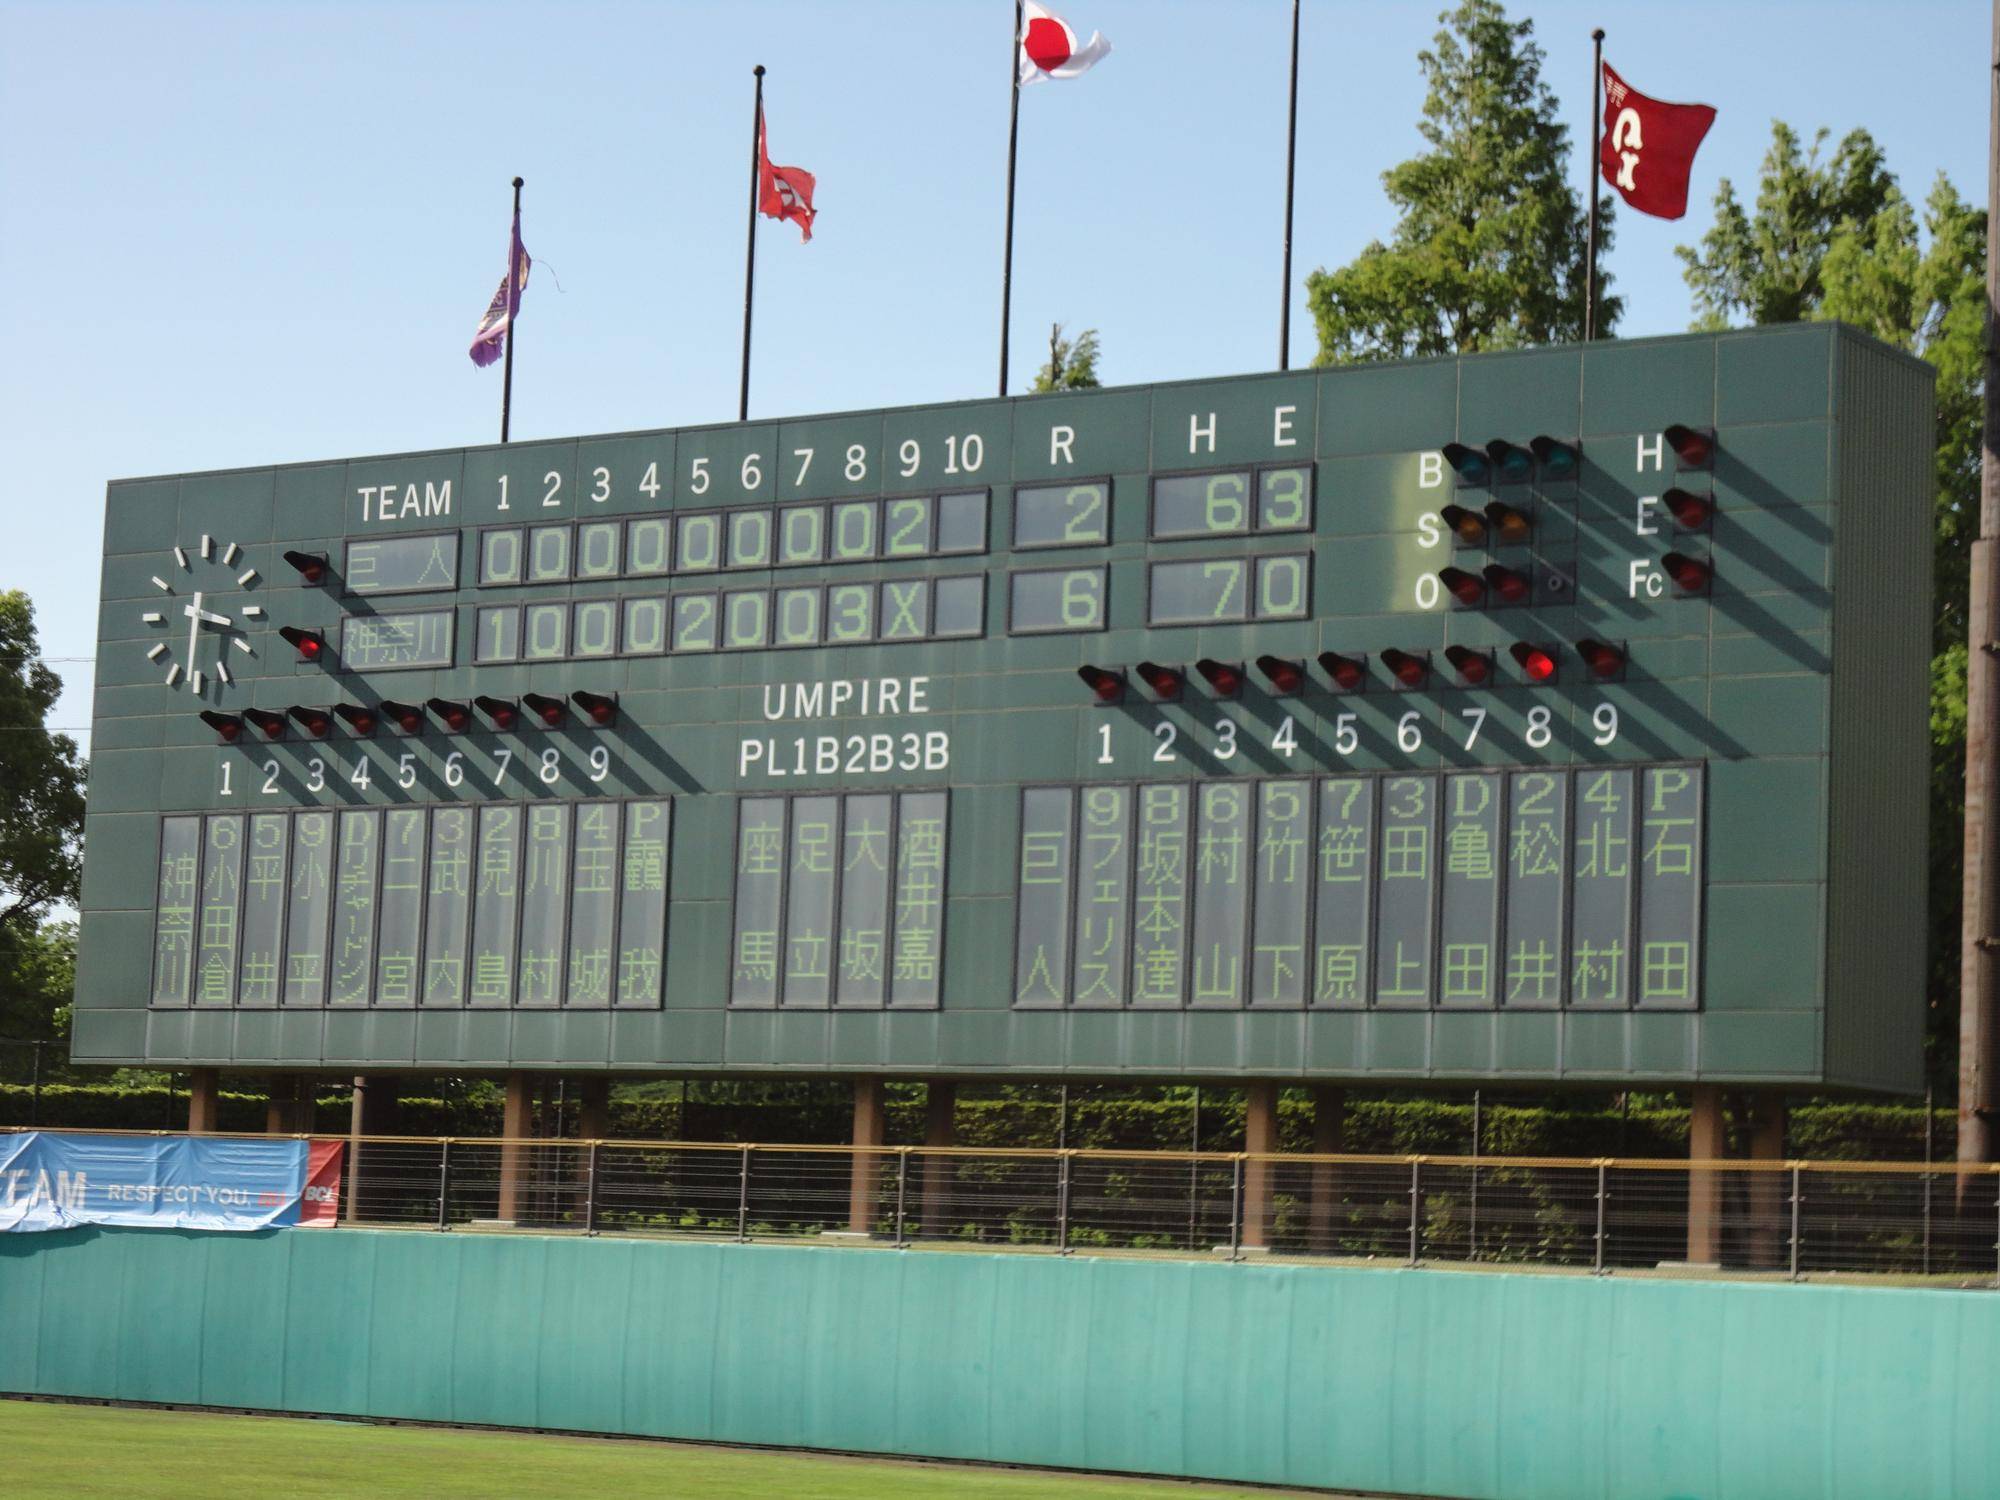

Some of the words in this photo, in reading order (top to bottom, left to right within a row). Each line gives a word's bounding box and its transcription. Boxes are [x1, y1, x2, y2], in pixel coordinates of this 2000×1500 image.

[357, 480, 452, 522] TEAM
[498, 475, 510, 511] 1
[542, 471, 562, 507] 2
[591, 467, 611, 503] 3
[638, 462, 661, 498] 4
[691, 458, 710, 495] 5
[741, 453, 762, 490] 6
[793, 448, 814, 486] 7
[844, 444, 867, 482] 8
[899, 439, 921, 477] 9
[944, 433, 984, 474] 10
[1050, 425, 1075, 465] R
[1189, 412, 1216, 454] H
[1274, 405, 1297, 447] E
[1418, 451, 1443, 489] B
[1636, 433, 1663, 473] H
[487, 530, 517, 582] 0
[535, 527, 566, 580] 0
[583, 524, 615, 577] 0
[632, 520, 665, 573] 0
[684, 516, 715, 570] 0
[733, 511, 766, 565] 0
[785, 507, 818, 561] 0
[837, 503, 872, 557] 0
[891, 501, 925, 554] 2
[1065, 485, 1101, 541] 2
[1206, 474, 1243, 531] 6
[1266, 469, 1304, 528] 3
[1417, 511, 1440, 549] S
[1637, 496, 1658, 535] E
[349, 537, 453, 591] 巨人
[1629, 559, 1663, 598] Fc
[490, 609, 502, 658] 1
[531, 608, 563, 658] 0
[579, 605, 611, 654] 0
[629, 600, 661, 650] 0
[679, 597, 712, 648] 2
[731, 592, 764, 646] 0
[782, 590, 817, 644] 0
[834, 587, 869, 641] 3
[887, 581, 922, 638] X
[1062, 570, 1098, 626] 6
[1204, 562, 1241, 619] 7
[1263, 556, 1300, 615] 0
[343, 612, 448, 665] 神奈川
[763, 676, 930, 721] UMPIRE
[1097, 723, 1114, 764] 1
[1153, 722, 1176, 762] 2
[1213, 720, 1237, 760] 3
[1271, 718, 1298, 757] 4
[1335, 715, 1358, 755] 5
[1397, 712, 1422, 753] 6
[1463, 710, 1486, 751] 7
[1525, 707, 1552, 748] 8
[1592, 704, 1618, 746] 9
[220, 761, 232, 796] 1
[261, 760, 279, 794] 2
[306, 759, 325, 792] 3
[350, 757, 371, 790] 4
[398, 754, 416, 789] 5
[444, 752, 463, 787] 6
[494, 750, 512, 786] 7
[539, 748, 560, 784] 8
[589, 746, 608, 782] 9
[1452, 776, 1491, 817] D
[1517, 774, 1556, 816] 2
[1583, 771, 1621, 814] 4
[1651, 769, 1690, 811] P
[484, 808, 513, 842] 2
[532, 806, 562, 841] 8
[582, 804, 610, 840] 4
[631, 802, 661, 839] P
[1087, 787, 1121, 825] 9
[1145, 785, 1180, 823] 8
[1204, 783, 1240, 822] 6
[1265, 781, 1301, 821] 5
[1327, 780, 1362, 819] 7
[1390, 778, 1426, 819] 3
[210, 816, 236, 849] 6
[254, 815, 281, 849] 5
[299, 814, 326, 848] 9
[345, 813, 372, 846] D
[392, 811, 419, 845] 7
[438, 810, 465, 843] 3
[288, 851, 327, 1000] 小平
[425, 850, 468, 1001] 武内
[520, 844, 562, 999] 川村
[570, 846, 615, 1000] 玉城
[735, 820, 782, 981] 座馬
[787, 822, 834, 978] 足立
[841, 818, 887, 980] 大坂
[894, 818, 942, 981] 酒井嘉
[1016, 830, 1063, 1000] 巨人
[1079, 829, 1122, 1000] フェリス
[1135, 829, 1183, 1000] 坂本達
[1196, 827, 1241, 999] 村山
[1255, 825, 1304, 1000] 竹下
[1318, 823, 1365, 999] 笹原
[1382, 824, 1428, 998] 田上
[1443, 820, 1493, 1000] 亀田
[1508, 819, 1559, 1000] 松井
[1574, 816, 1626, 1000] 北村
[1643, 817, 1692, 1000] 石田
[155, 852, 196, 1001] 神奈川
[198, 852, 237, 1000] 小田倉
[246, 855, 282, 999] 平井
[379, 857, 419, 1000] 二宮
[108, 1183, 201, 1204] RESPECT
